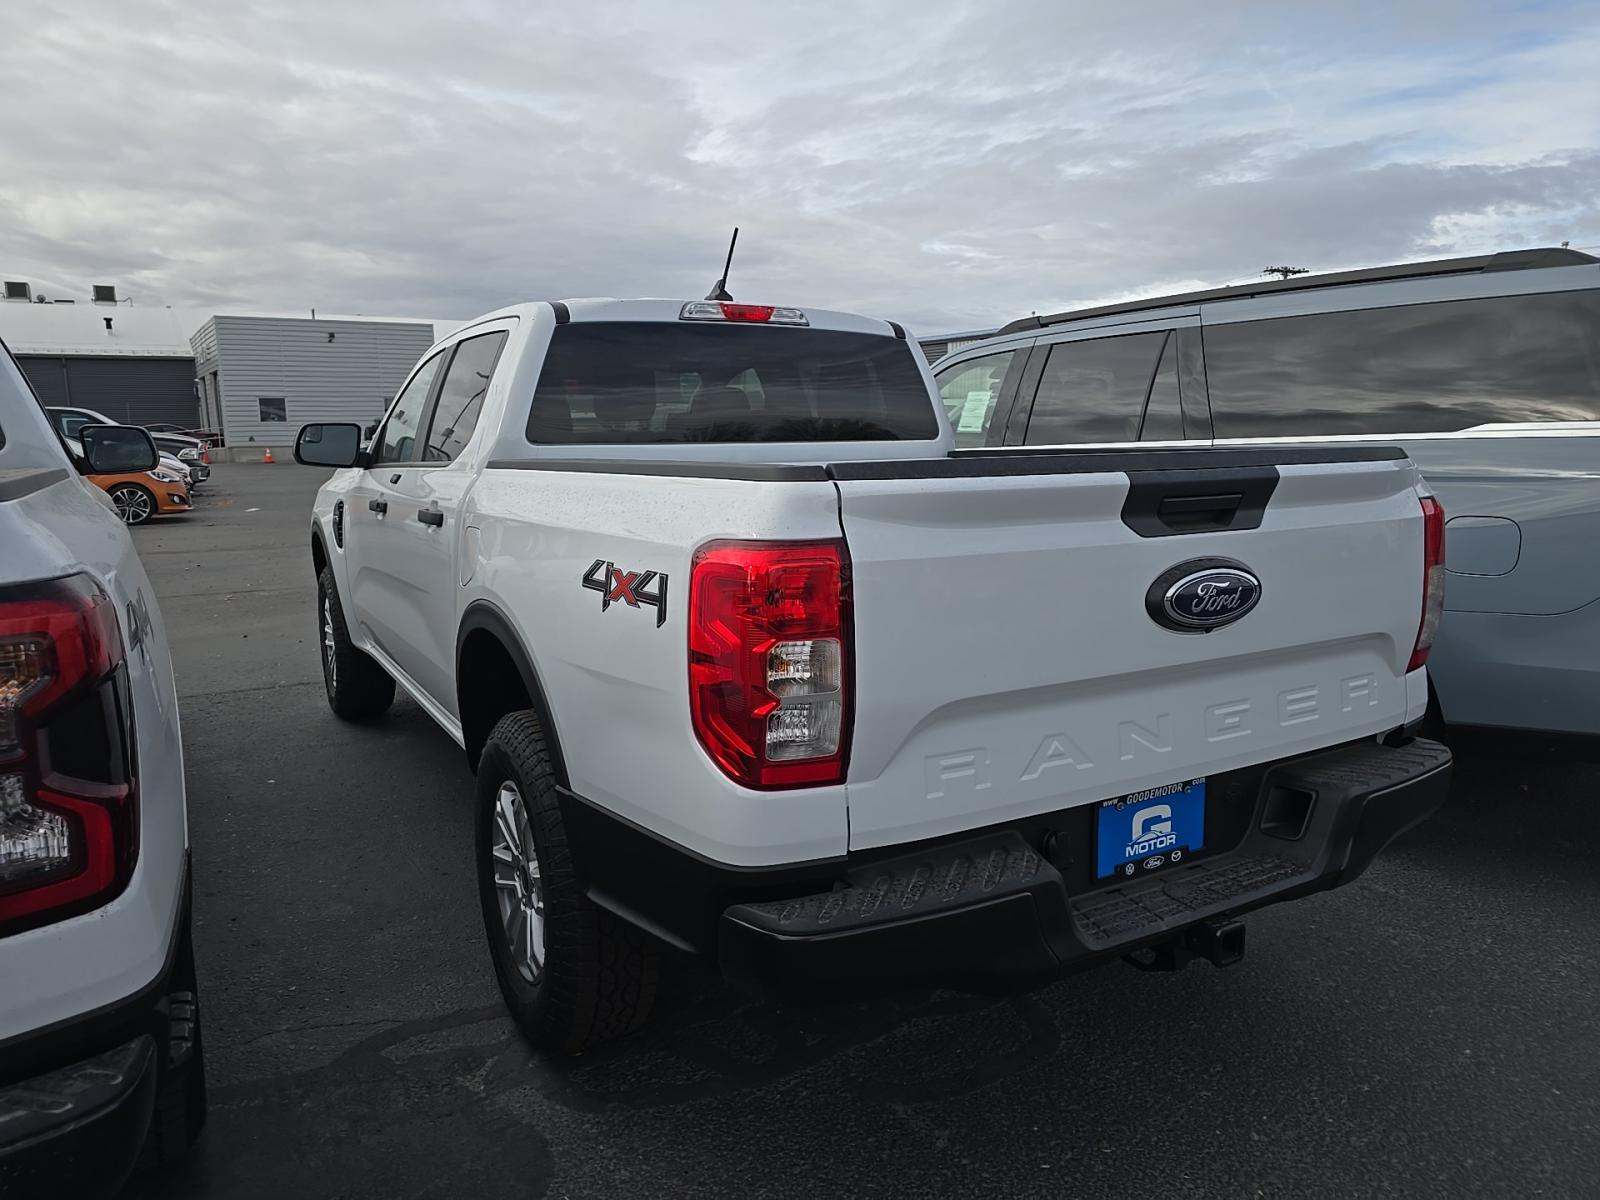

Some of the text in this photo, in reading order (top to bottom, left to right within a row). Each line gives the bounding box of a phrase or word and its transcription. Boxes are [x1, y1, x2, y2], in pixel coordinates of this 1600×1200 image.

[1192, 581, 1242, 613] Ford
[924, 672, 1379, 799] RANGER
[1126, 783, 1184, 804] GOODEMOTOR
[1126, 834, 1176, 857] MOTOR
